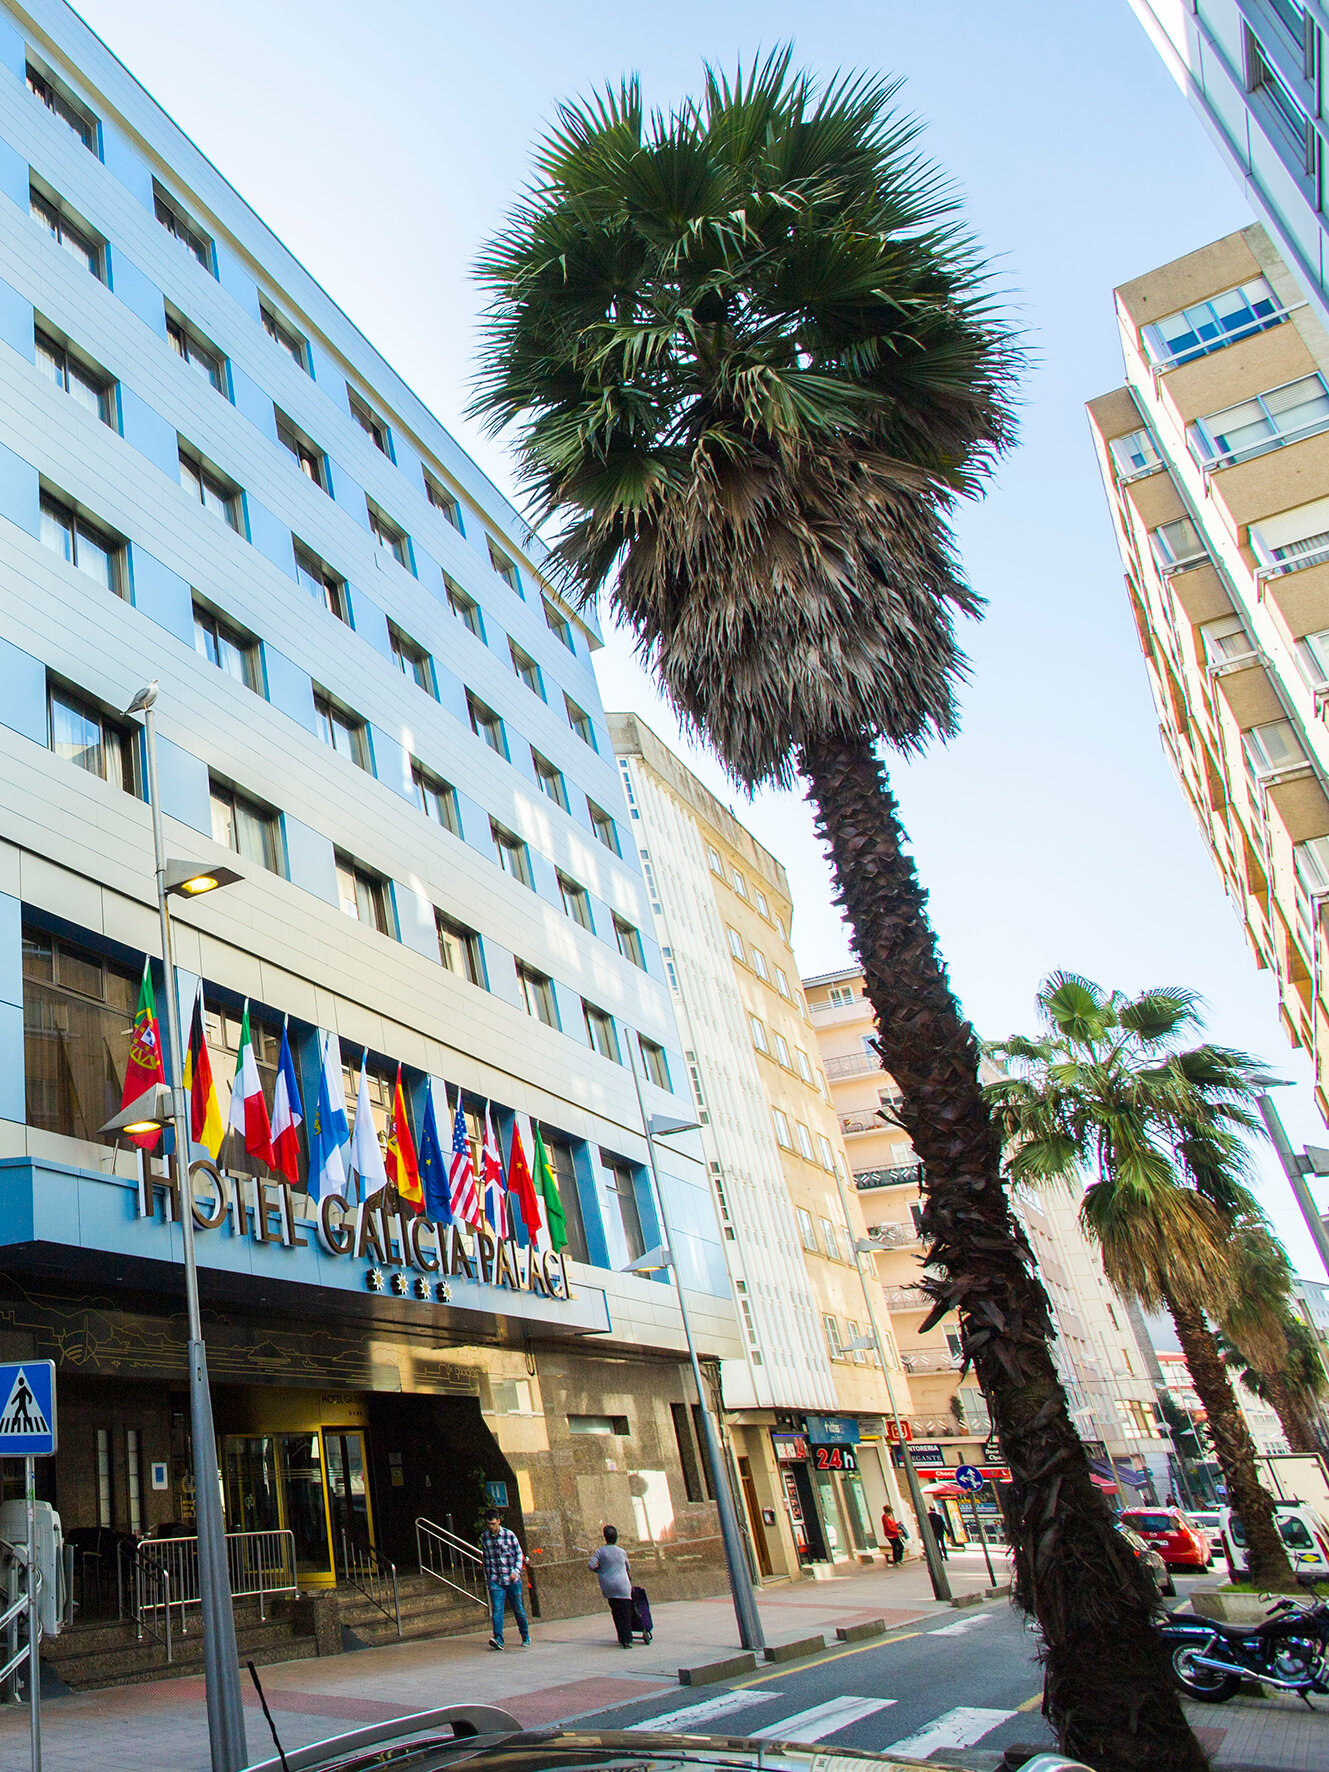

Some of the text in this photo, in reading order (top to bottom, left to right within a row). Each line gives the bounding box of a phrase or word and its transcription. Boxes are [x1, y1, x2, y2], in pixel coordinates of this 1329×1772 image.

[136, 1147, 308, 1247] HOTEL
[317, 1194, 473, 1279] GALICIA
[817, 1448, 855, 1469] 24h
